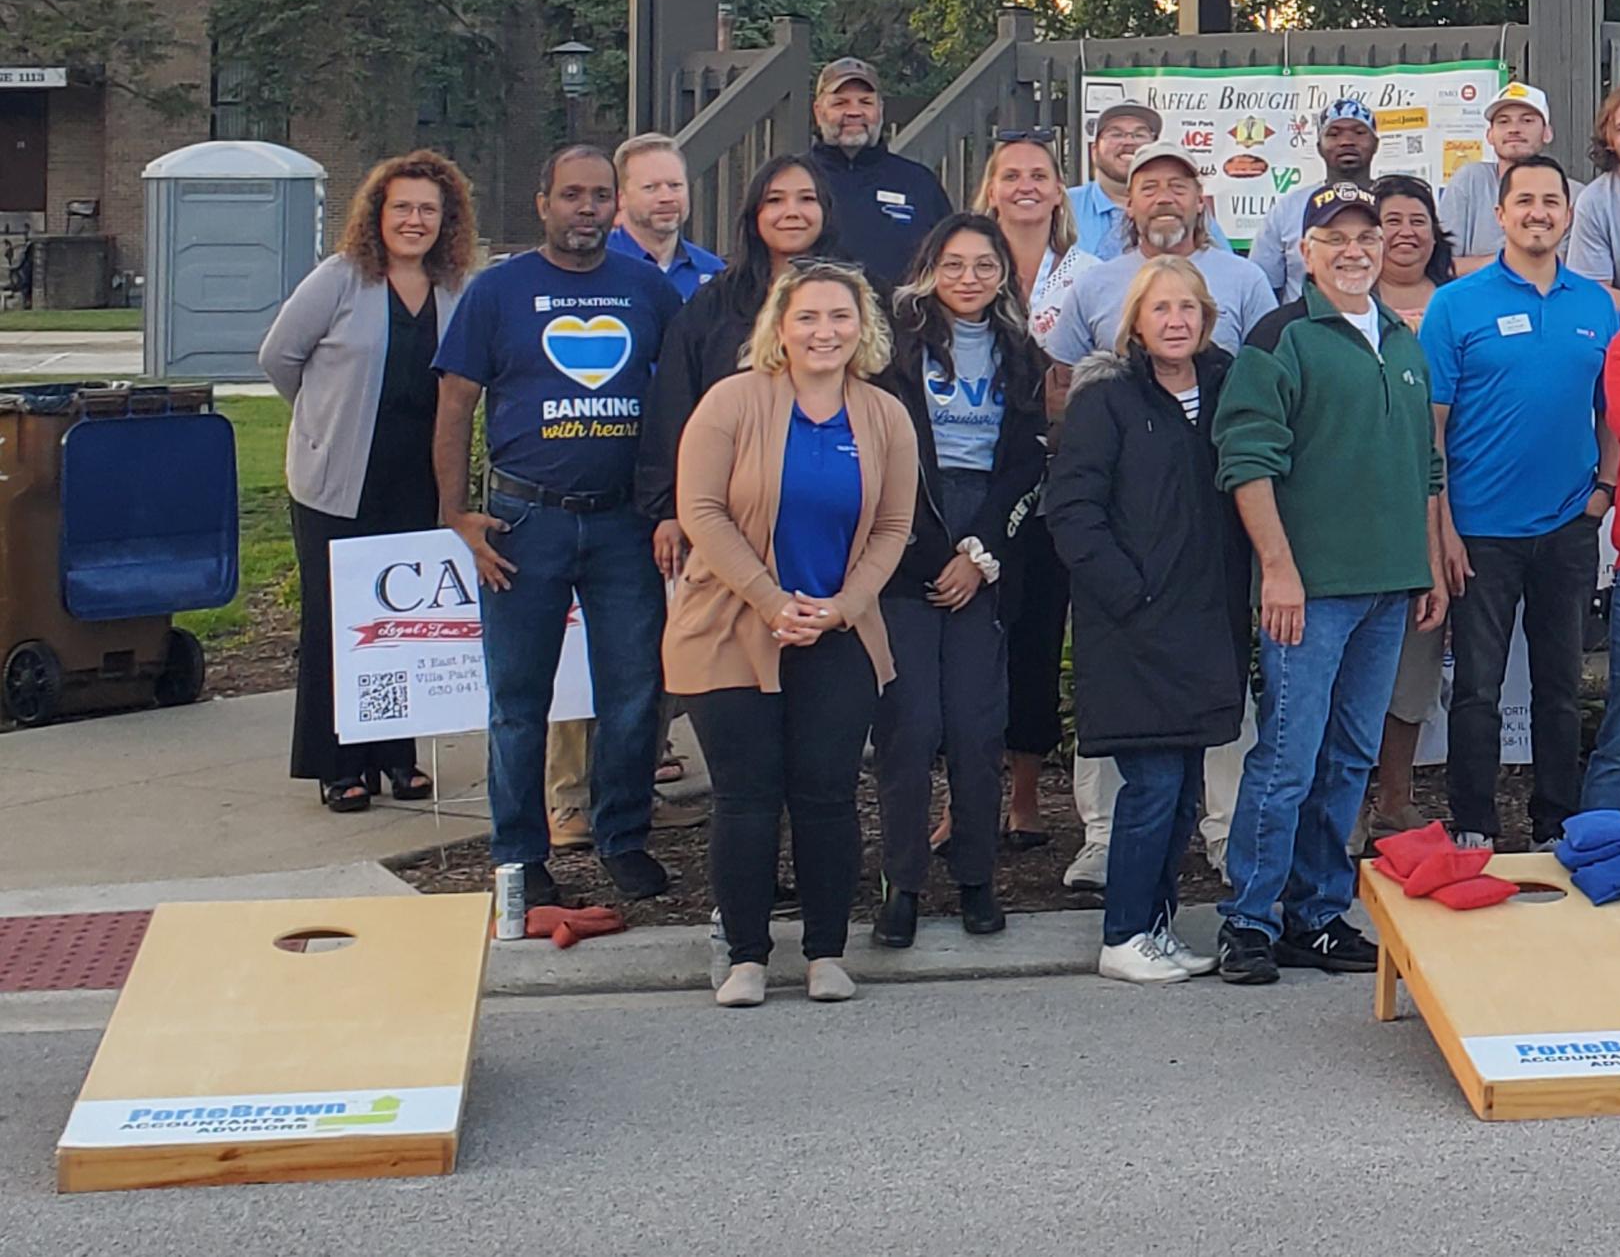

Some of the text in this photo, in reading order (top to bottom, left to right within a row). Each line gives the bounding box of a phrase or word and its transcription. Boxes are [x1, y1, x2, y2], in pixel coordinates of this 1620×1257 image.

[1181, 129, 1214, 147] ACE
[552, 297, 631, 307] OLD NATIONAL
[543, 398, 640, 420] BANKING
[541, 420, 638, 439] with heart
[374, 558, 477, 613] CA
[431, 656, 456, 668] East
[462, 654, 484, 664] Par
[416, 673, 443, 683] Villa
[128, 1102, 347, 1123] PorteBrown
[120, 1117, 286, 1131] ACCOUNTANTS
[197, 1124, 308, 1134] ADVISORS
